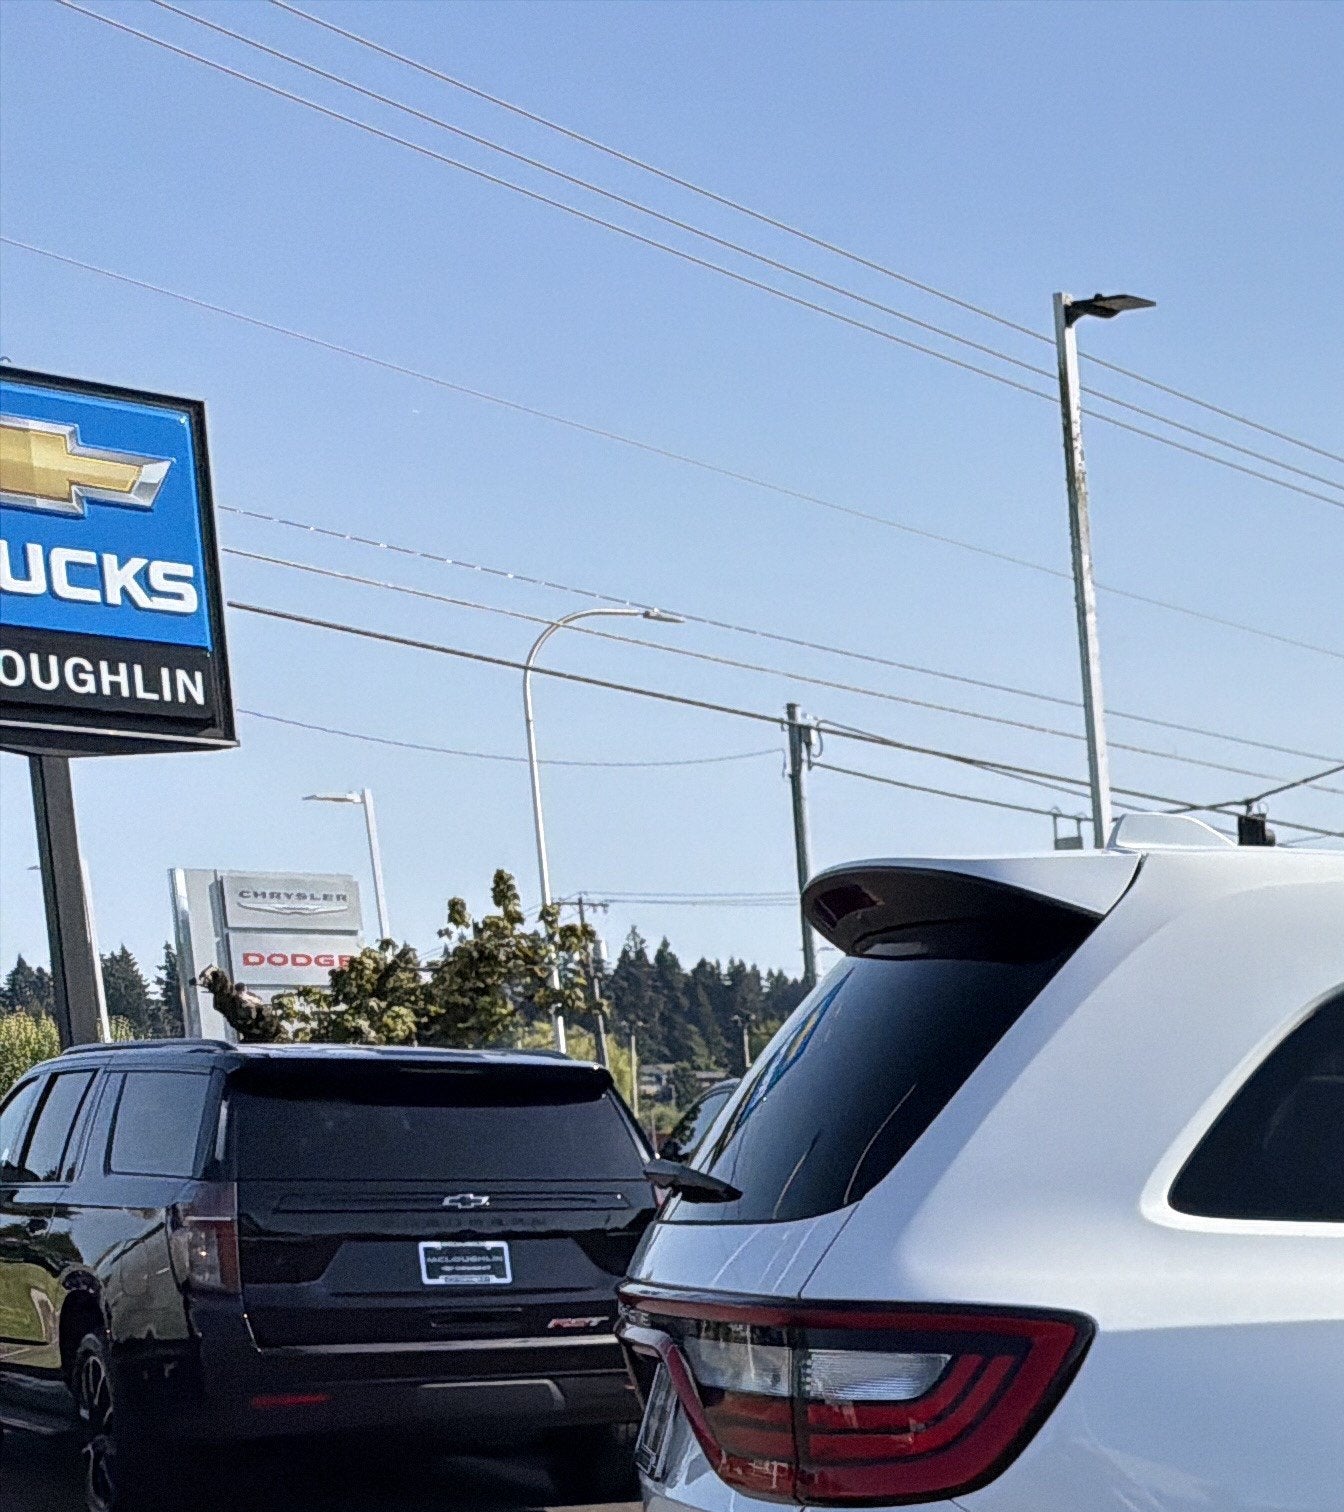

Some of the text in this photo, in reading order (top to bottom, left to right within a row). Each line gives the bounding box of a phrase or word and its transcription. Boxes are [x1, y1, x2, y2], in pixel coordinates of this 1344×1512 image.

[0, 540, 199, 615] UCKS
[0, 651, 206, 706] OUGHLIN
[238, 890, 347, 902] CHRYSLER
